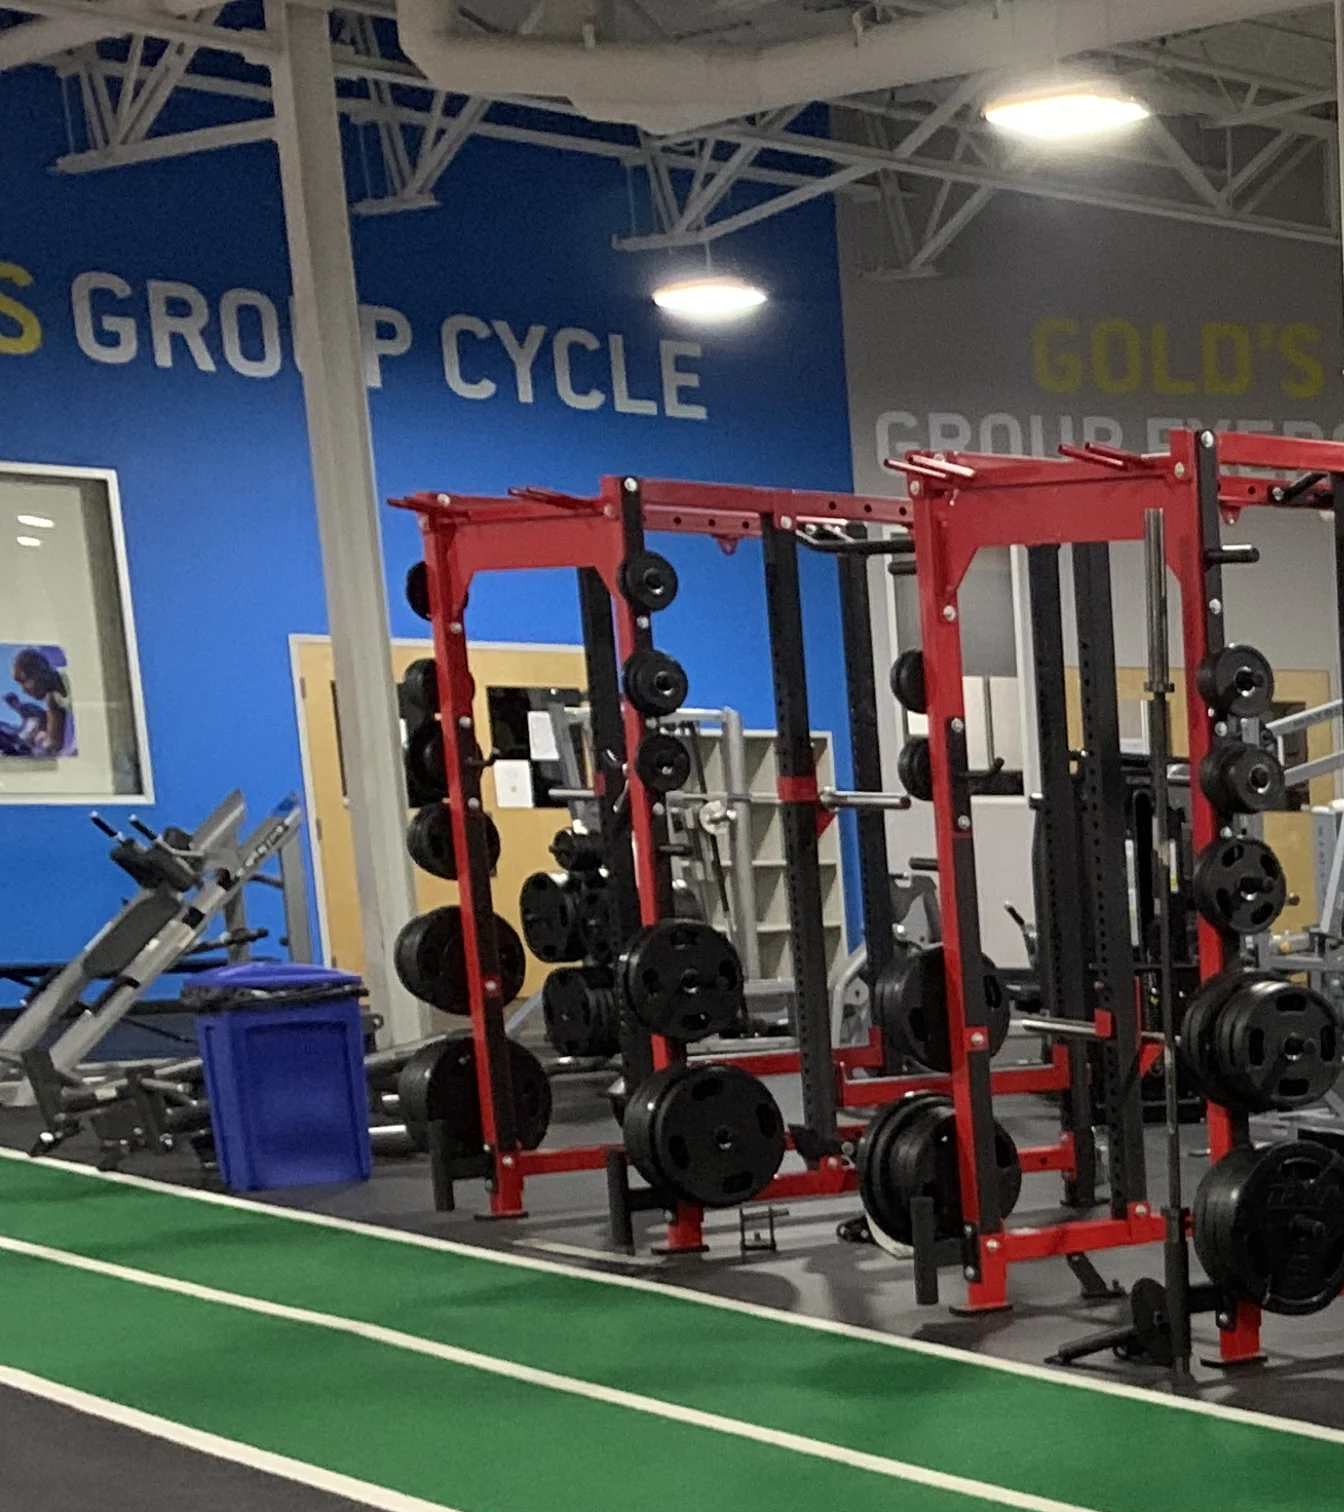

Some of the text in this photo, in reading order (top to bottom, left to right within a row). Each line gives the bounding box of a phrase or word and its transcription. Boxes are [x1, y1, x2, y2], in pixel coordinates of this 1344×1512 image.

[72, 271, 412, 389] GROP
[441, 314, 708, 421] CYCLE
[1032, 316, 1326, 398] GOLD'S
